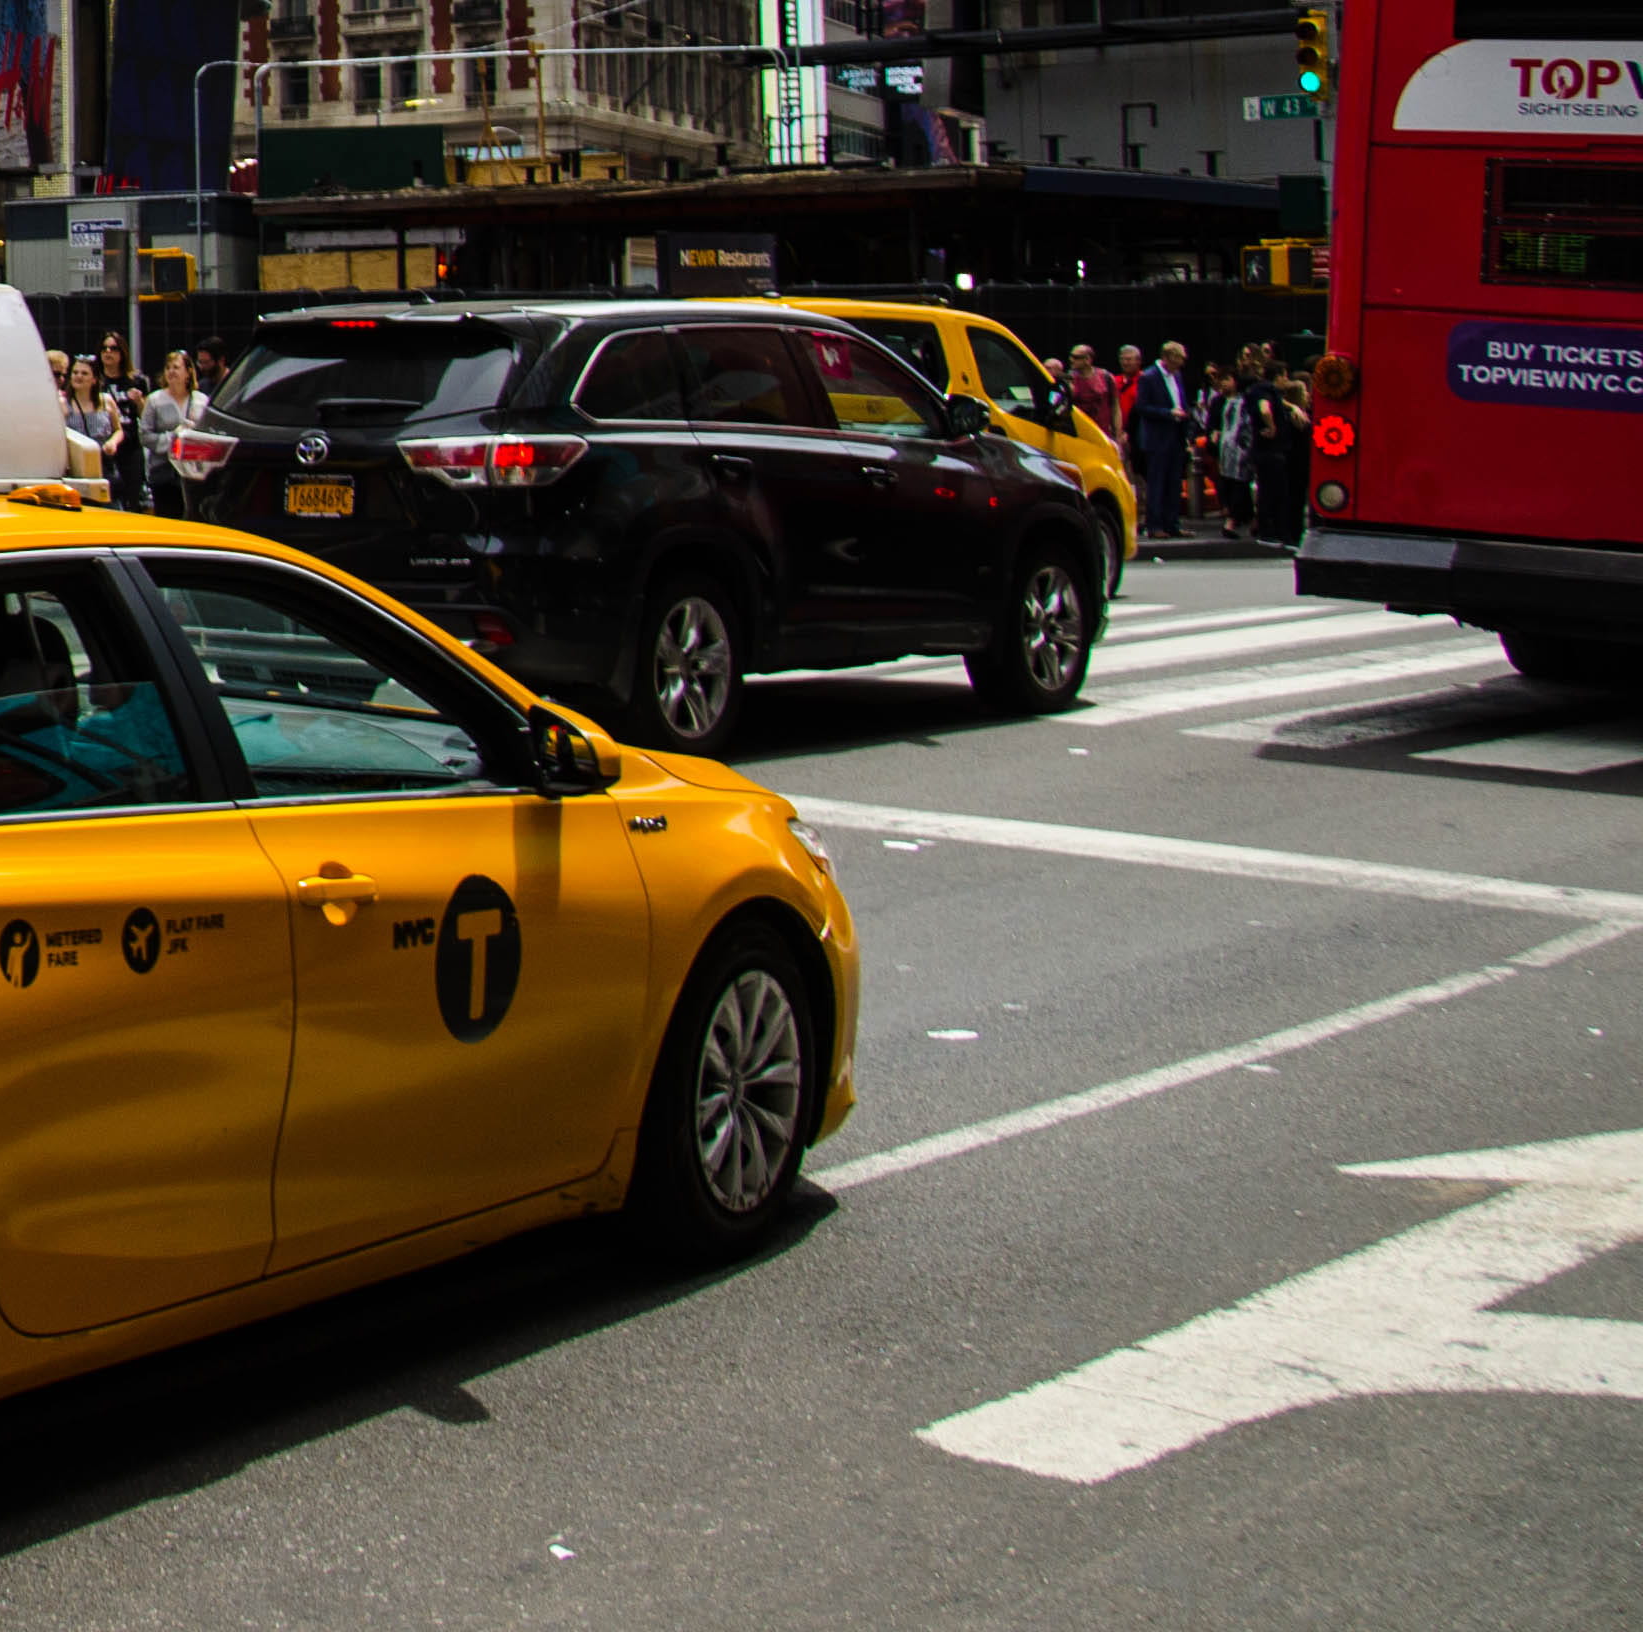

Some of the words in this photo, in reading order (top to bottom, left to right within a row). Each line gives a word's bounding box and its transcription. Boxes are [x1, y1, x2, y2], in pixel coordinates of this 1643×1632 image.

[1262, 101, 1276, 116] W
[1283, 98, 1300, 114] 43
[1517, 102, 1639, 118] SIGHTSEEING
[1487, 341, 1535, 361] BUY
[1540, 344, 1643, 368] TICKETS
[166, 918, 194, 933] FLAT
[196, 913, 224, 931] FARE
[46, 928, 102, 948] METERED
[166, 937, 189, 955] JFK
[47, 951, 79, 967] FARE
[393, 918, 435, 950] NYC
[457, 908, 503, 1020] T
